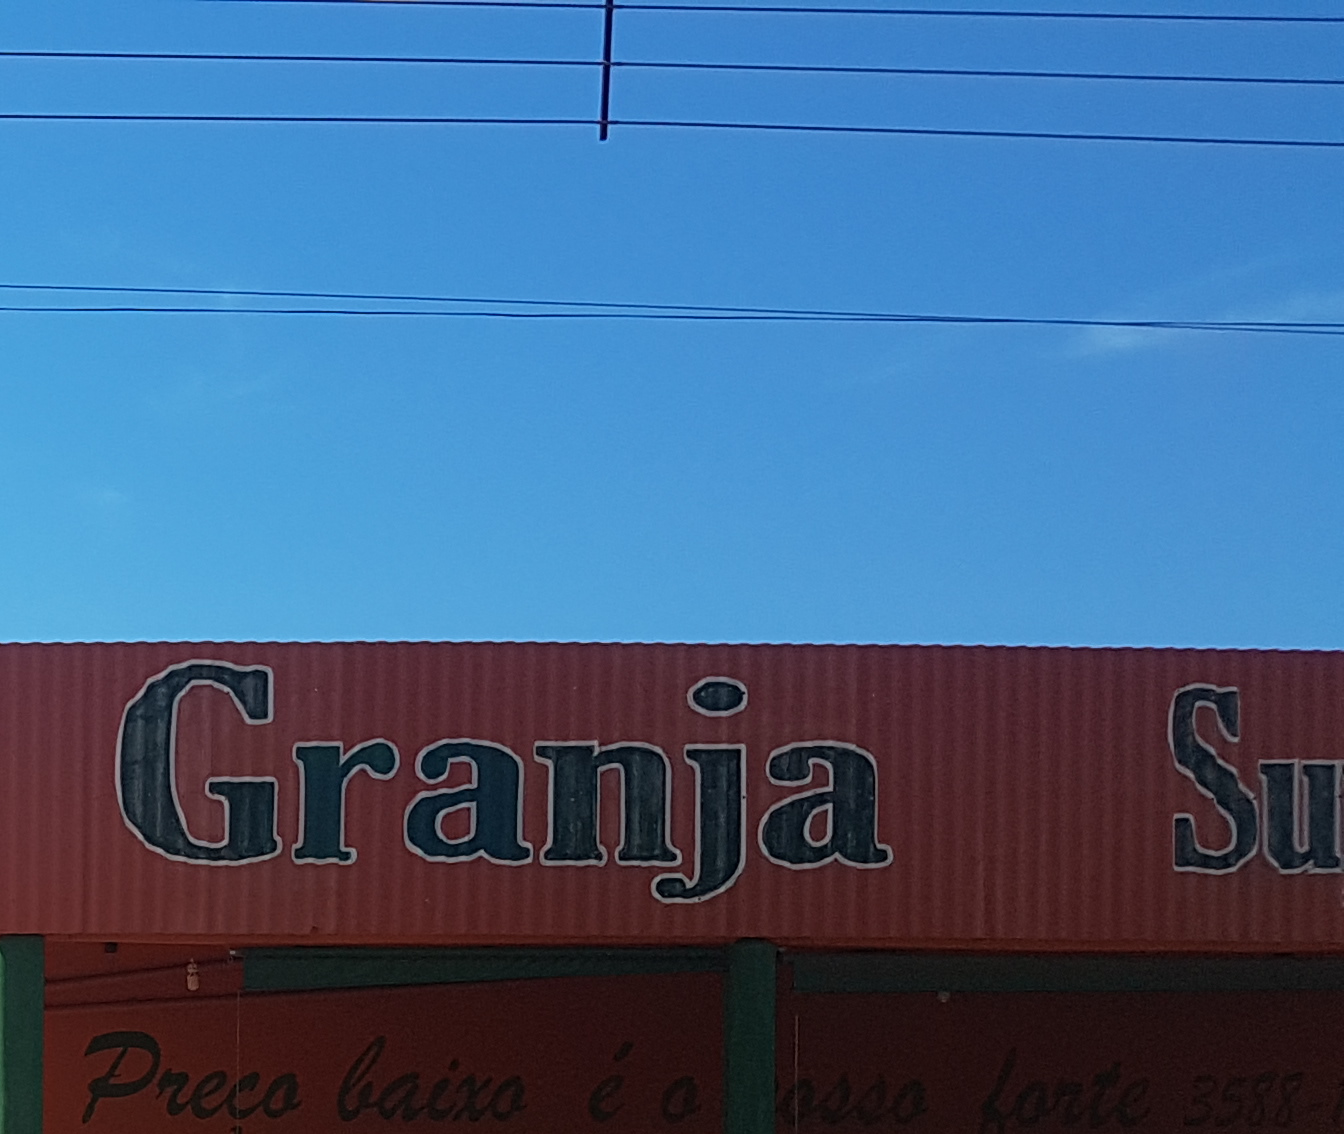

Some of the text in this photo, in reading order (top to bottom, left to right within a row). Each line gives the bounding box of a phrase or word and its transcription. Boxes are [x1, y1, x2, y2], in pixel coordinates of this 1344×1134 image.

[115, 659, 892, 904] Granja
[338, 1035, 528, 1124] baixo
[588, 1041, 634, 1124] é
[661, 1069, 699, 1123] o
[774, 1070, 930, 1127] osso
